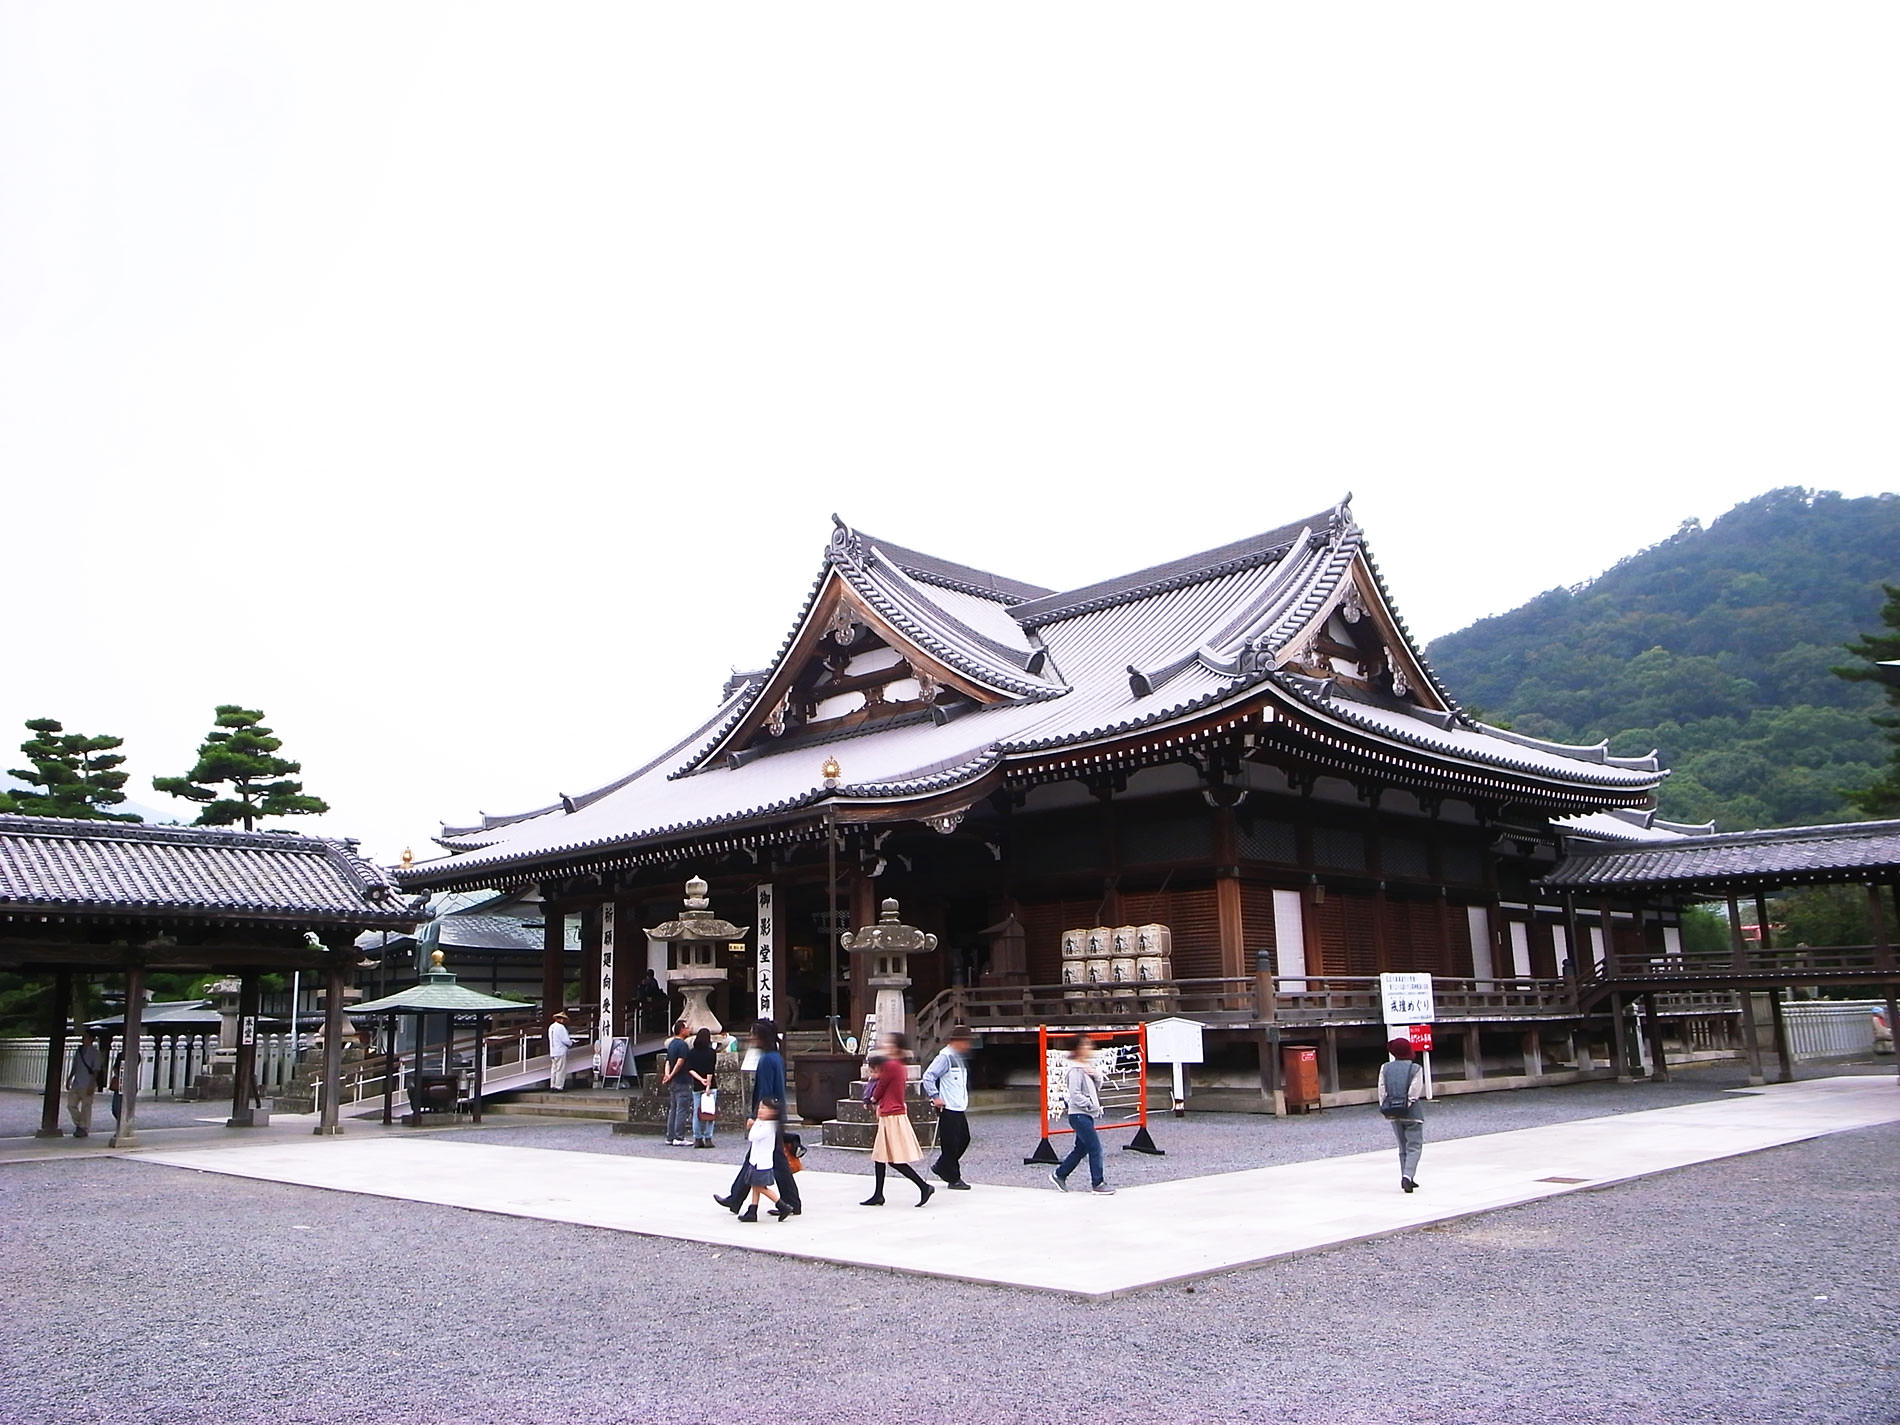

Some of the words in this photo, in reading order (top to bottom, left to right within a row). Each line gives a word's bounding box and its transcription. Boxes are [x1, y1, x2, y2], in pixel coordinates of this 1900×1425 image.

[759, 890, 771, 1019] 御影堂(大師
